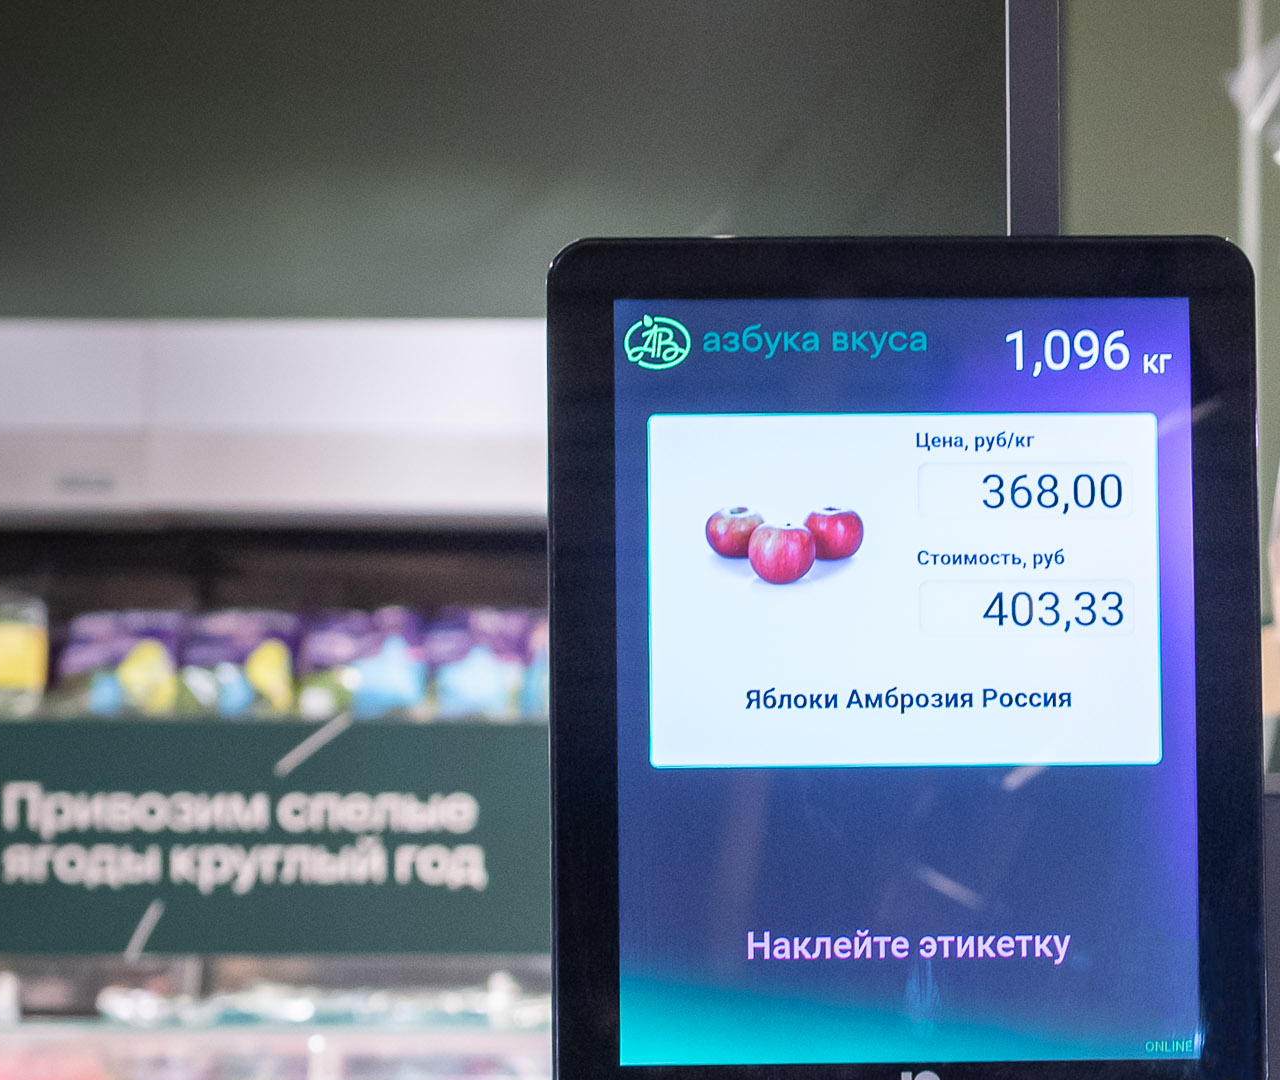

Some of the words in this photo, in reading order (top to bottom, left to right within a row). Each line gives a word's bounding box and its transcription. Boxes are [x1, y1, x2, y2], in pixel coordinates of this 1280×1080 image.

[702, 323, 820, 360] азбука
[831, 330, 928, 359] вкуса
[1004, 328, 1131, 378] 1,096
[1142, 353, 1173, 375] кг
[915, 431, 969, 452] Цена,
[974, 430, 1035, 452] руб/кг
[981, 473, 1123, 515] 368,00
[916, 550, 1027, 569] Стоимость,
[1032, 548, 1066, 570] руб
[982, 591, 1124, 633] 403,33
[745, 687, 839, 710] Яблоки
[845, 686, 974, 714] Амброзия
[981, 687, 1072, 708] Россия
[1, 784, 270, 842] Привозим
[276, 791, 480, 834] спелые
[1, 843, 162, 889] ягоды
[168, 834, 388, 895] круглый
[393, 843, 488, 891] год
[746, 928, 910, 960] Наклейте
[919, 933, 1071, 966] этикетку
[1144, 1040, 1193, 1053] ONLINE
